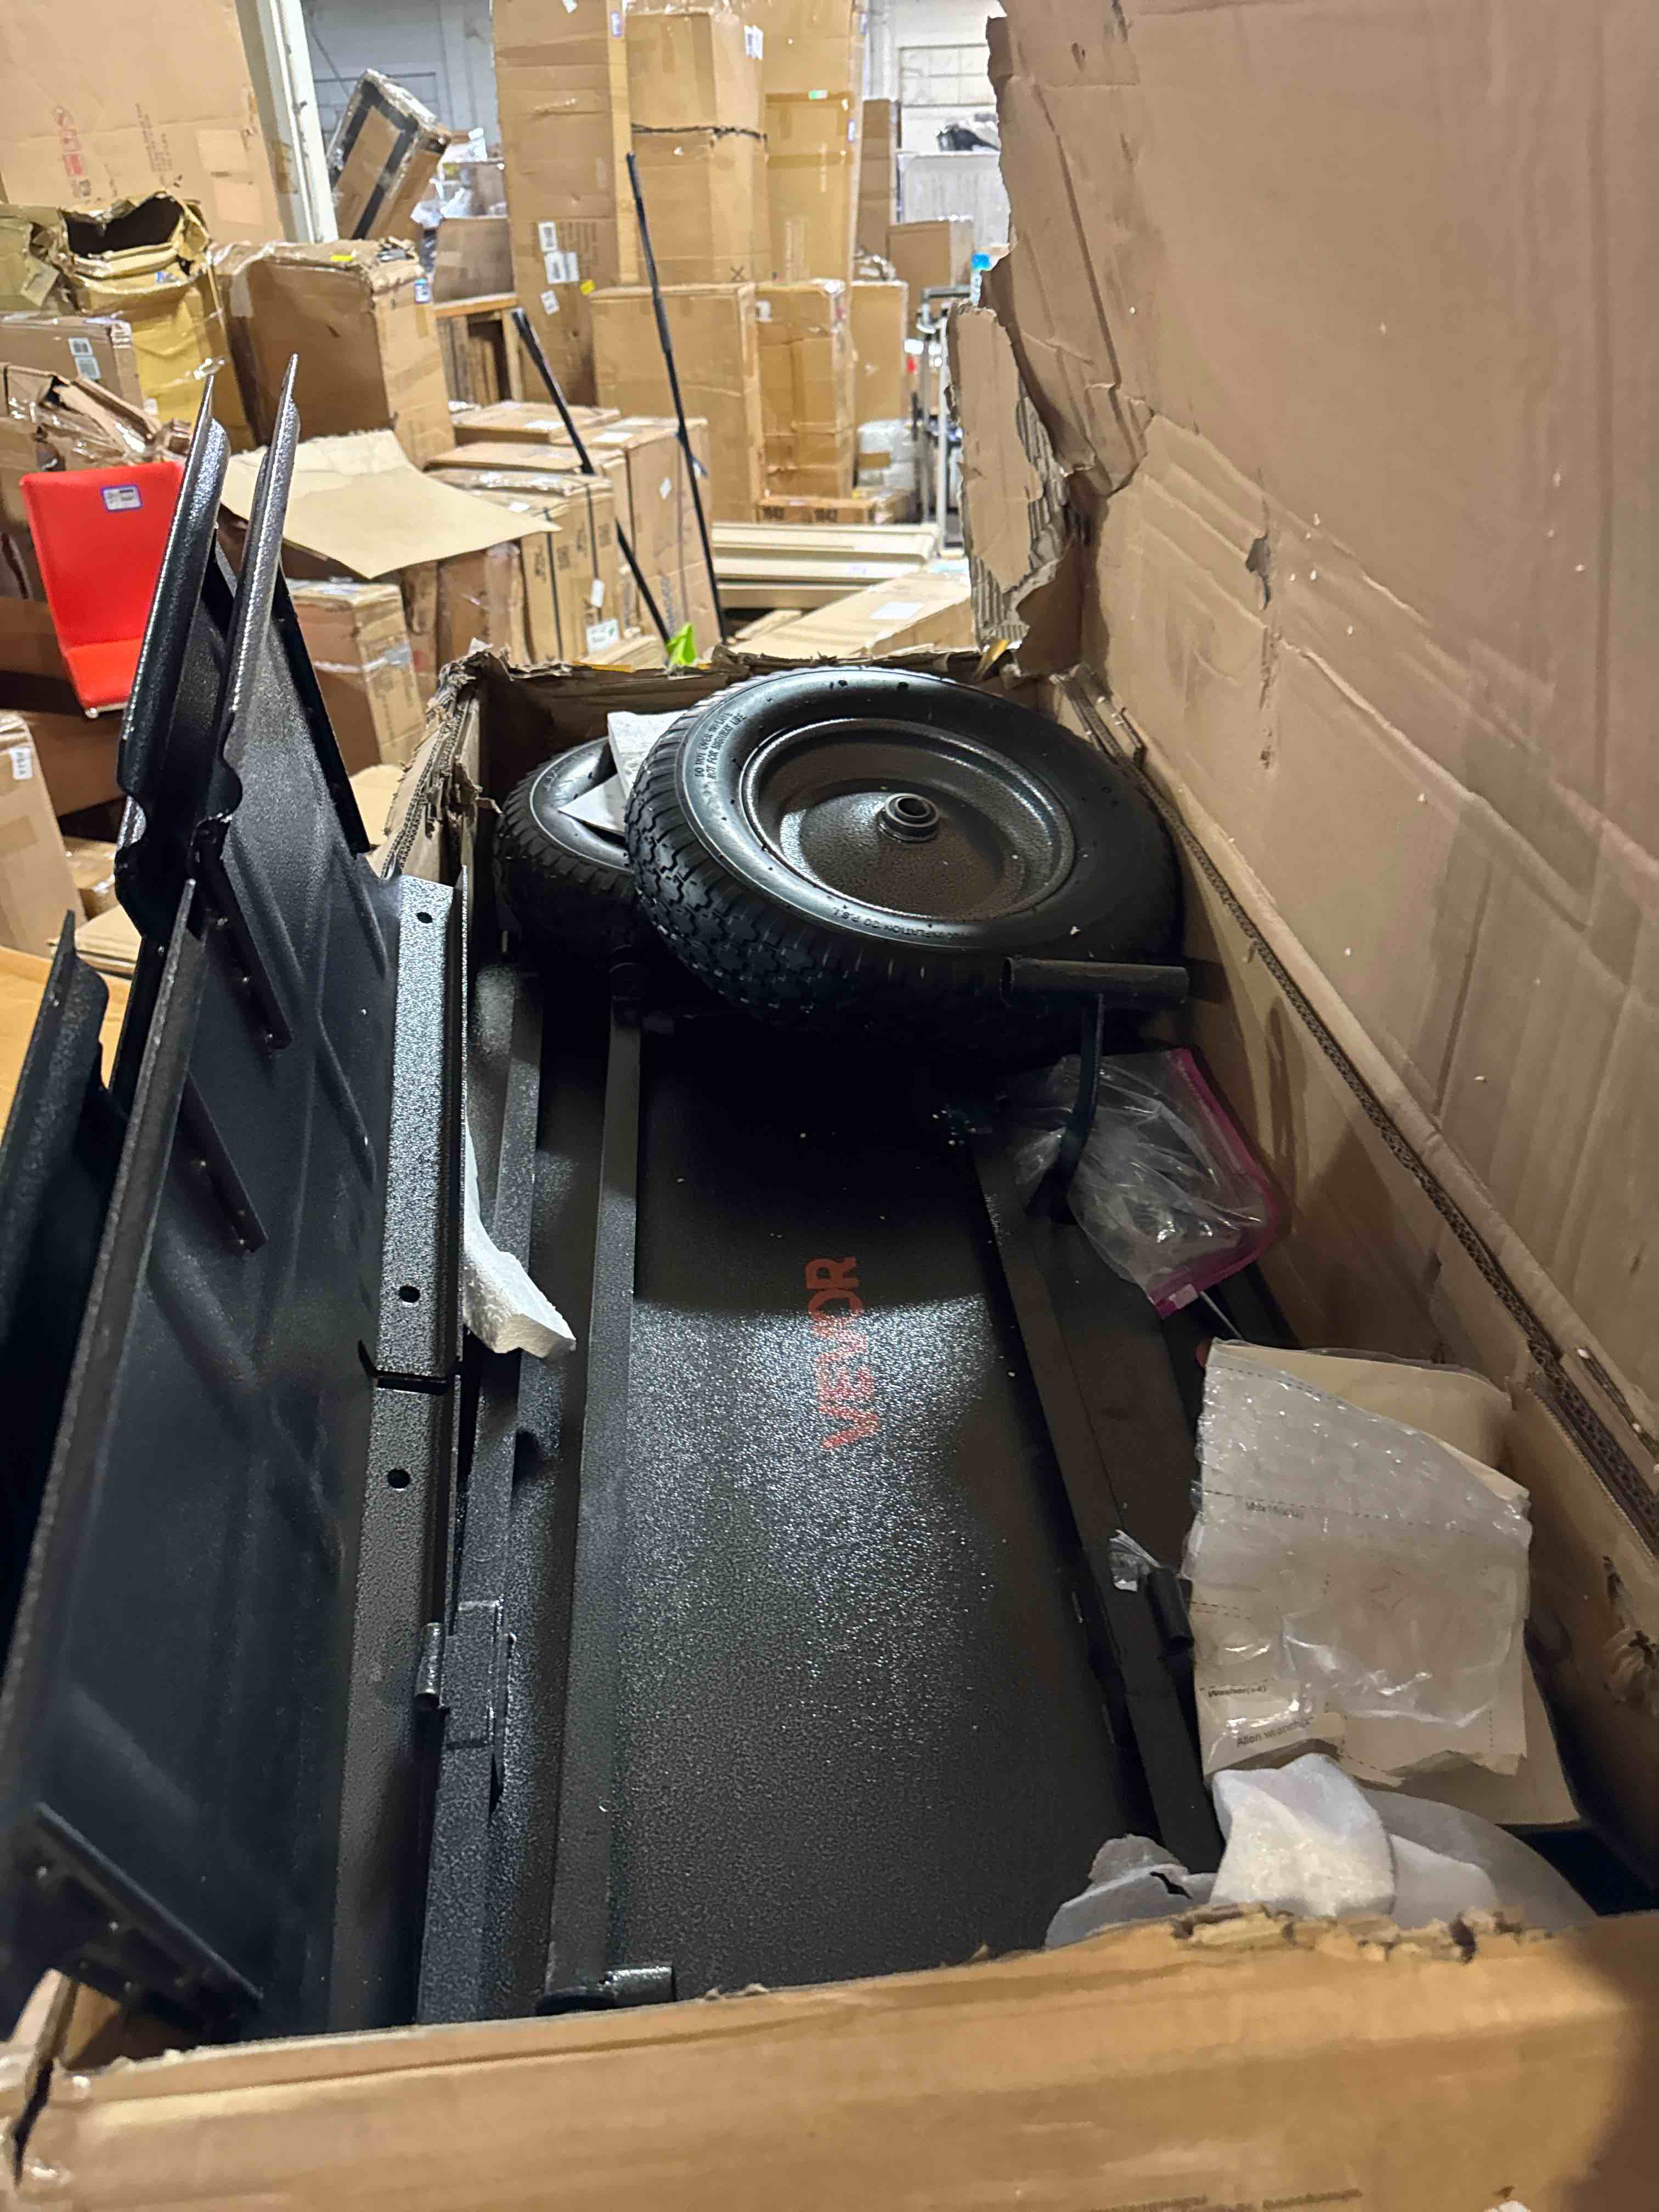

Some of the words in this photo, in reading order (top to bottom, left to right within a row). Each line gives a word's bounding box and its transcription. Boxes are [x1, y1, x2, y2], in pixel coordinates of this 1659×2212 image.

[698, 733, 713, 750] OVER
[695, 752, 706, 765] NOT
[707, 750, 719, 764] FOR
[695, 768, 705, 777] DO
[706, 765, 716, 780] NOT
[805, 1255, 882, 1451] VEVOR
